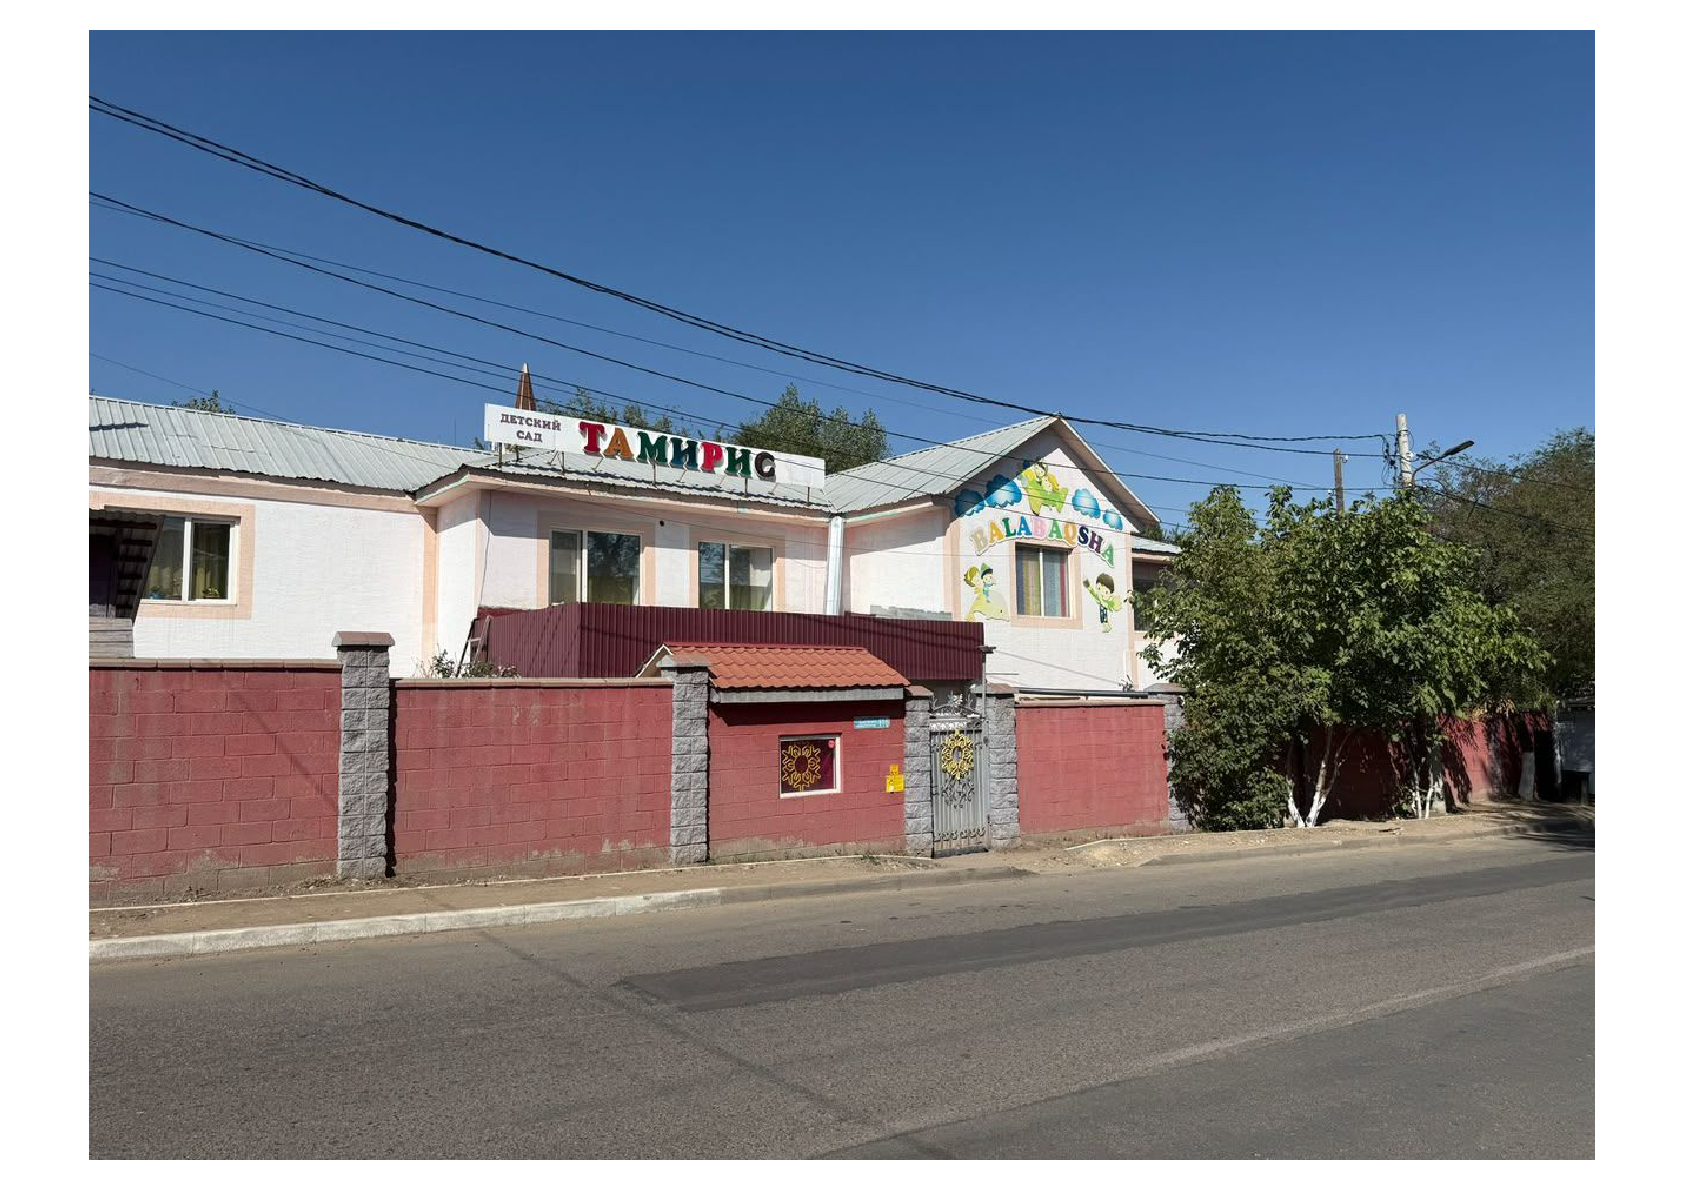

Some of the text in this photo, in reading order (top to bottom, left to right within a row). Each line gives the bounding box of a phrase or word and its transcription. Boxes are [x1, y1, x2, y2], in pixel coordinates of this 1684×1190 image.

[500, 413, 562, 431] ДЕТСКИЙ
[516, 429, 543, 443] САД
[578, 421, 776, 481] ТАМИРИС
[971, 515, 1115, 567] BALABAQSHA
